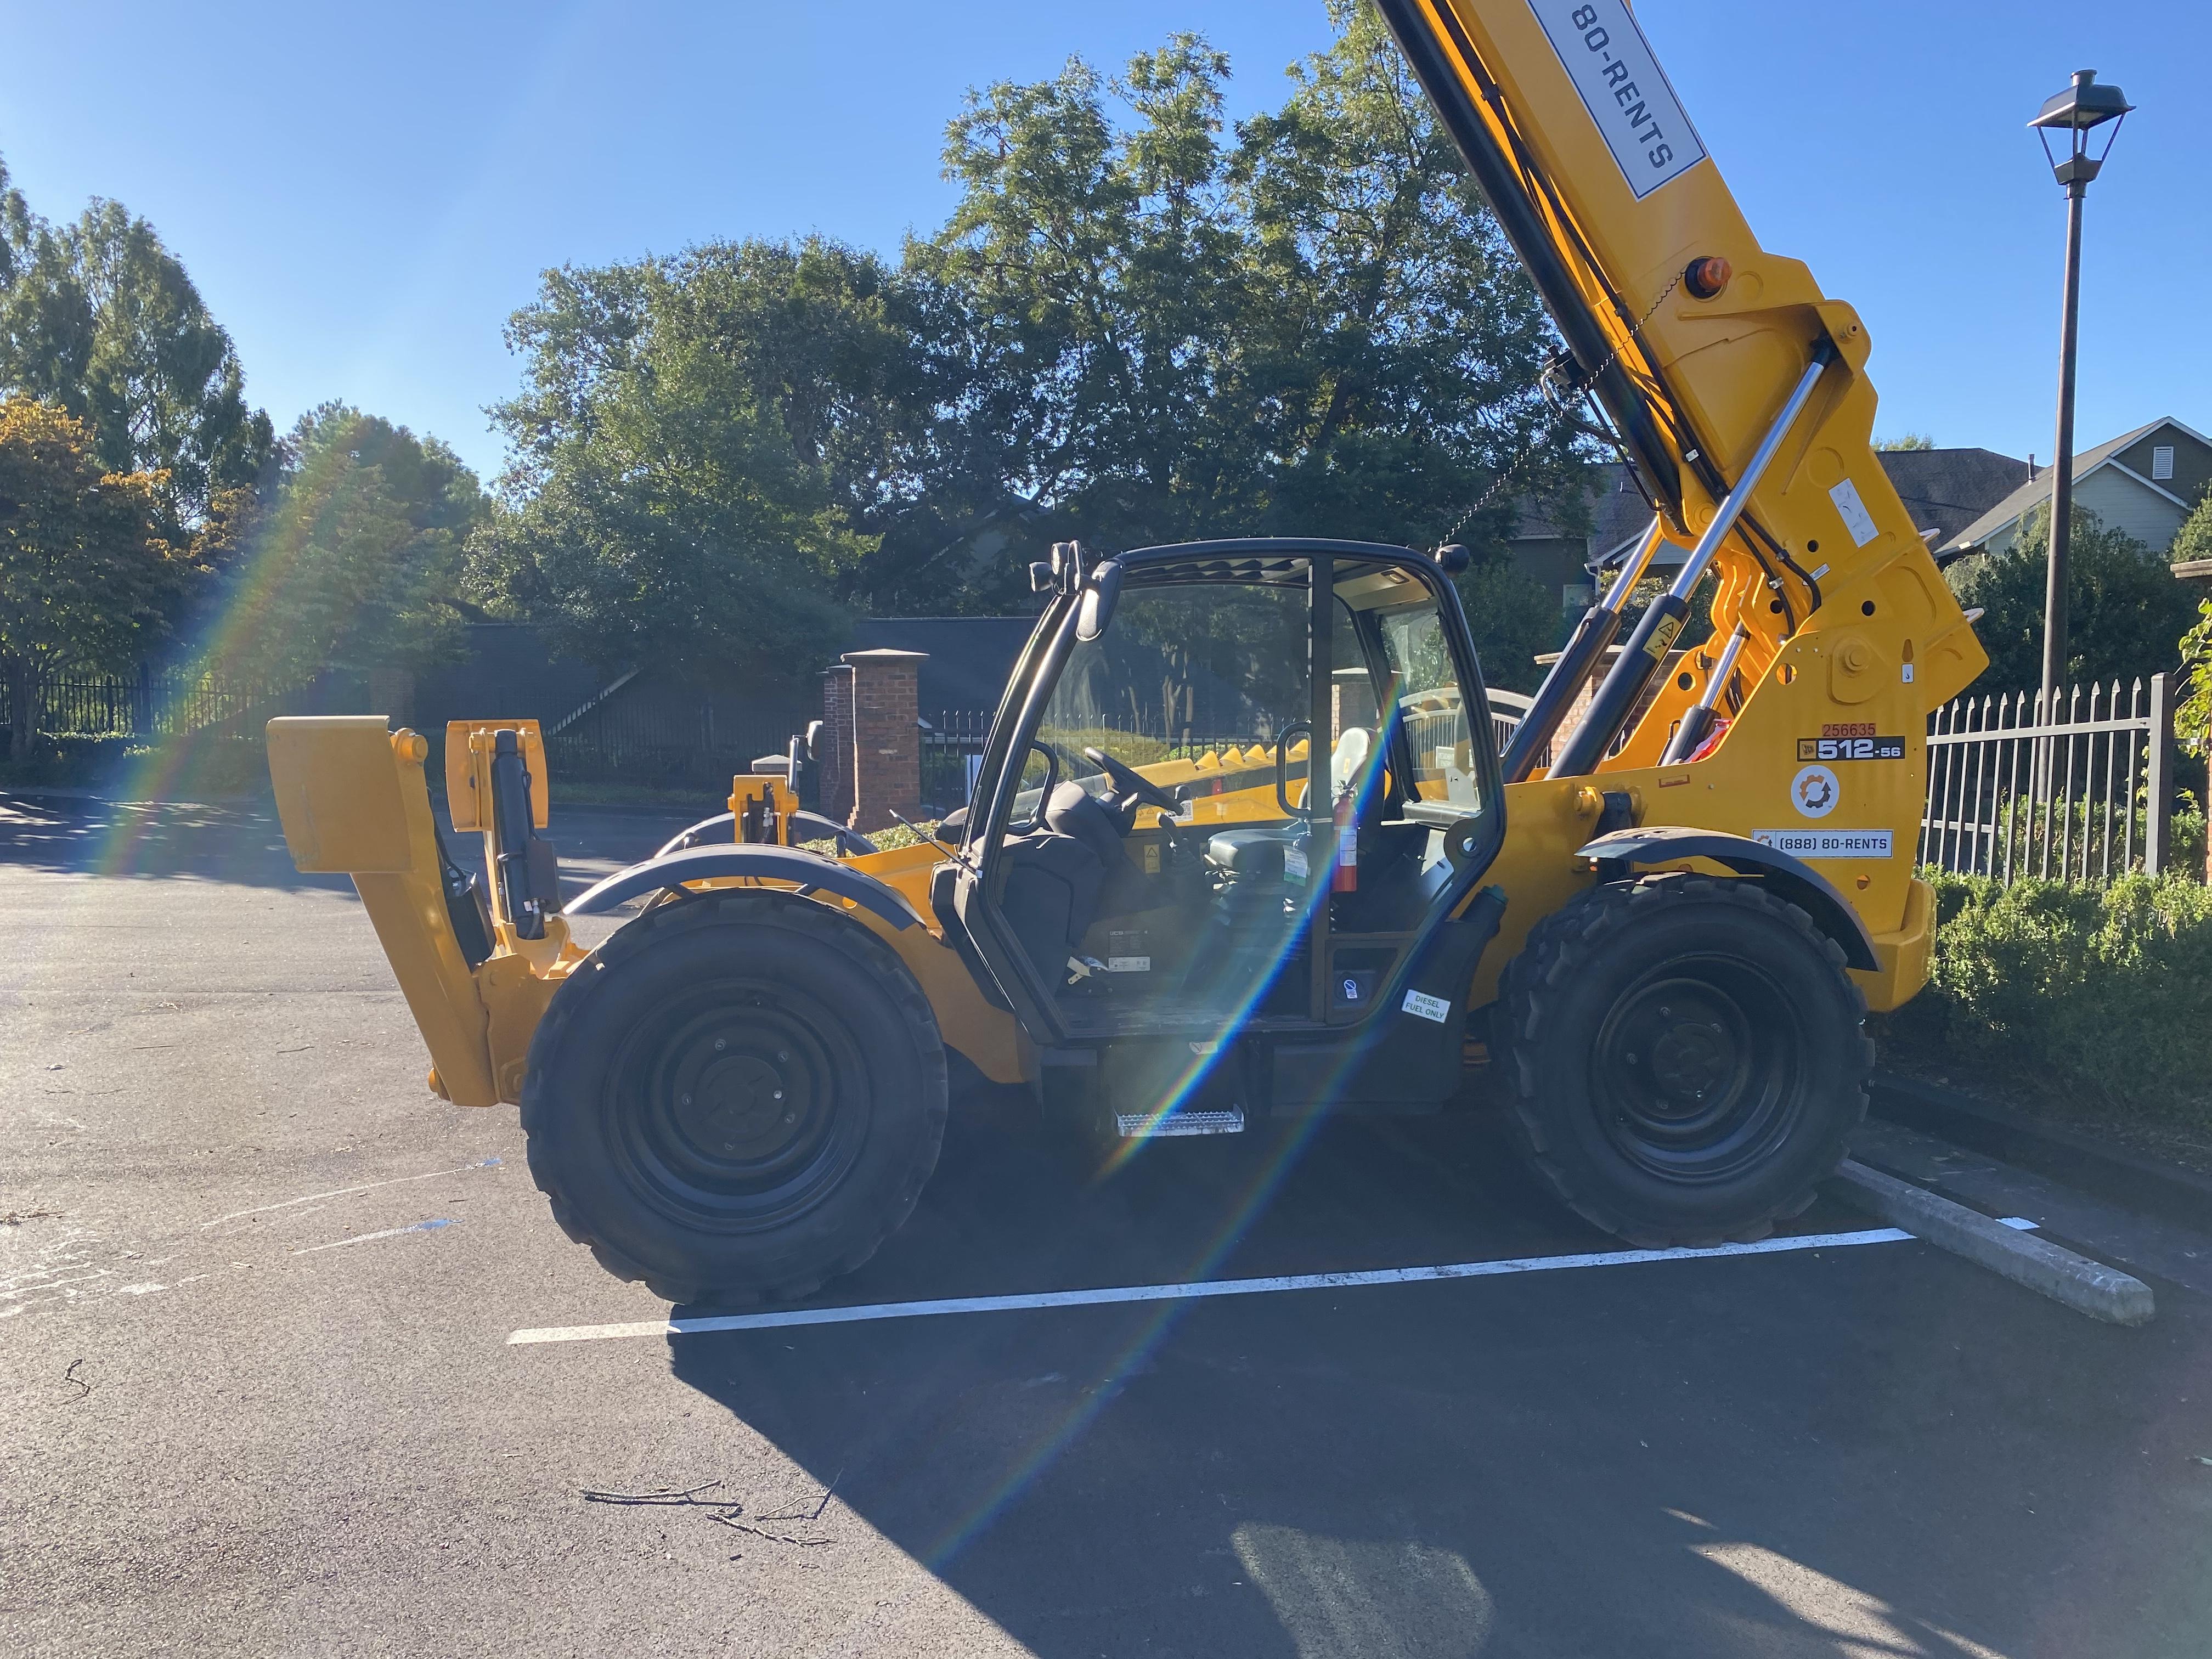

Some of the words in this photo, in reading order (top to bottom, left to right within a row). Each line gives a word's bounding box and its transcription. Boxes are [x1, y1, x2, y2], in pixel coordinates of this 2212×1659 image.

[1572, 4, 1673, 168] 80-RENTS
[1823, 724, 1875, 736] 256635
[1780, 838, 1816, 850] (888)
[1822, 838, 1887, 849] 80-RENTS
[1415, 995, 1440, 1008] DIESEL
[1406, 1002, 1423, 1013] FUEL
[1425, 1009, 1444, 1019] ONLY
